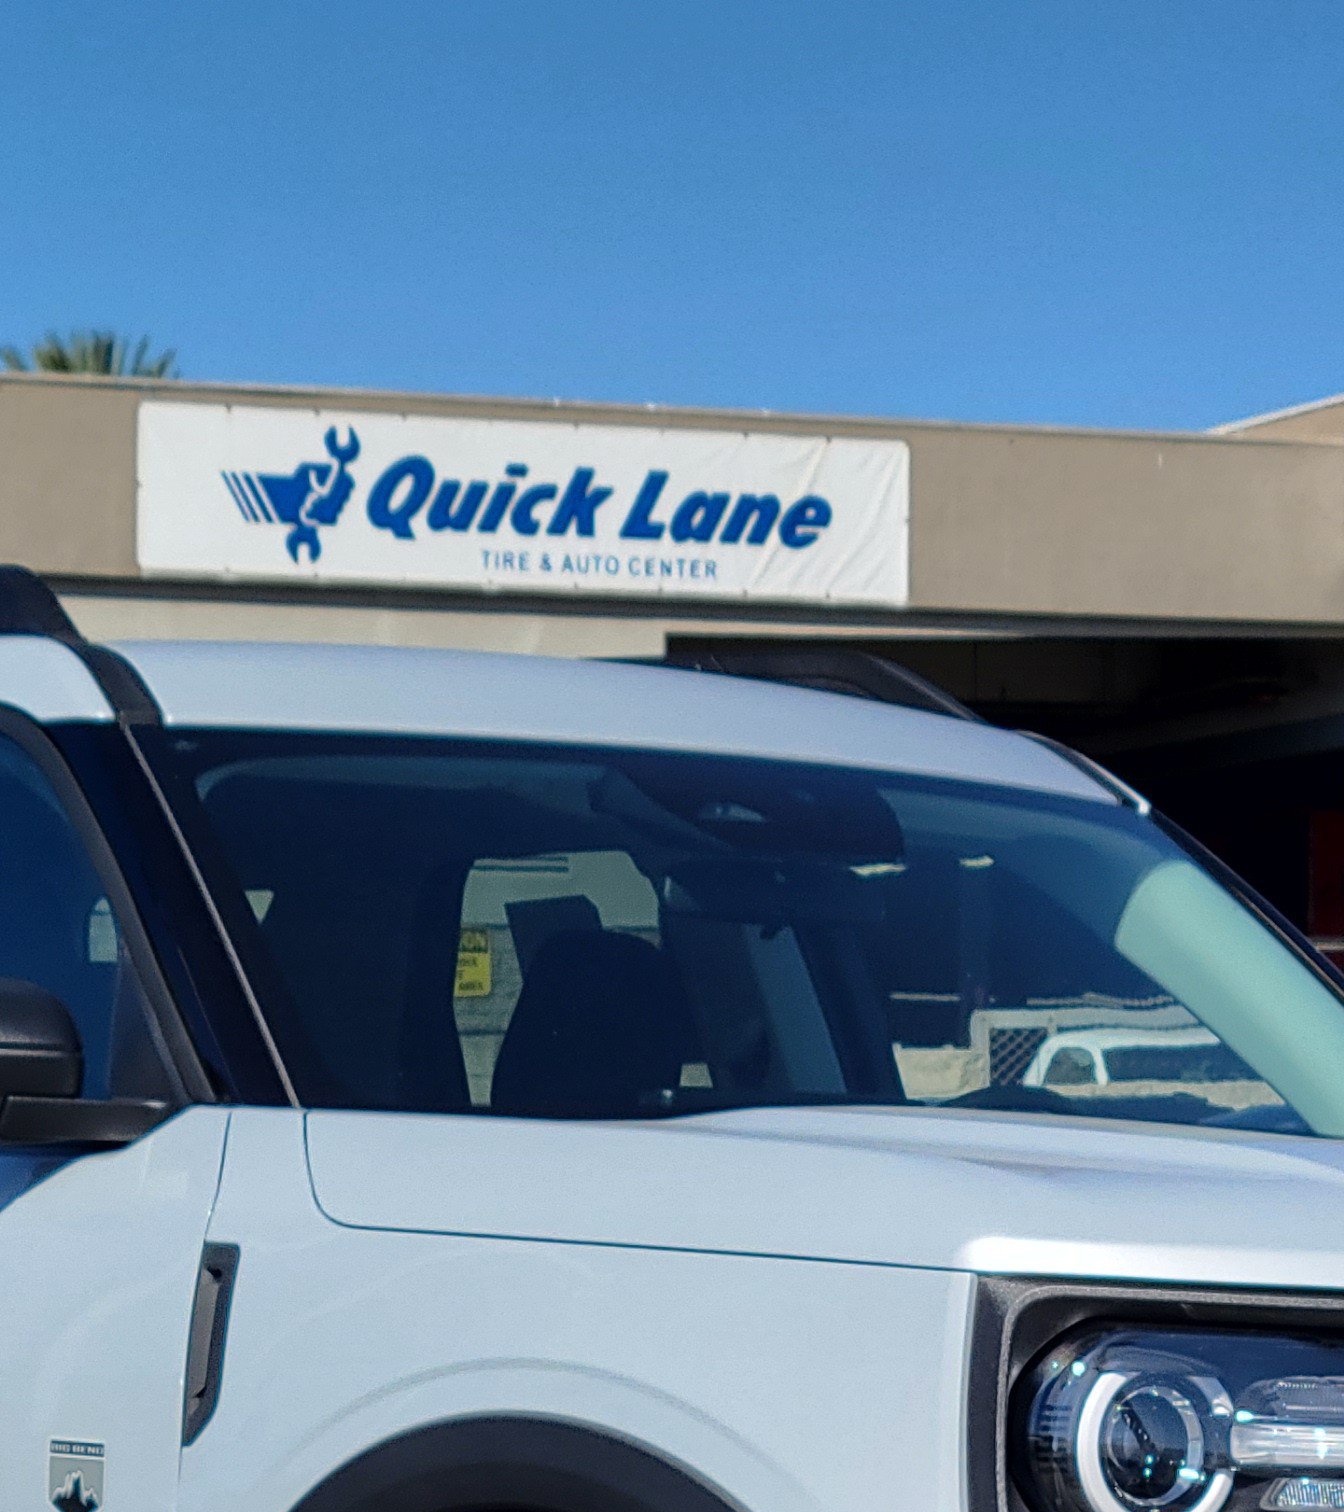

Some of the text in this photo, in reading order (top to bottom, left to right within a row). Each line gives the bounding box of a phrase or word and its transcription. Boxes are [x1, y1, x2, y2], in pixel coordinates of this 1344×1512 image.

[366, 454, 833, 550] Quick Lane
[482, 550, 719, 580] TIRE & AUTO CENTER
